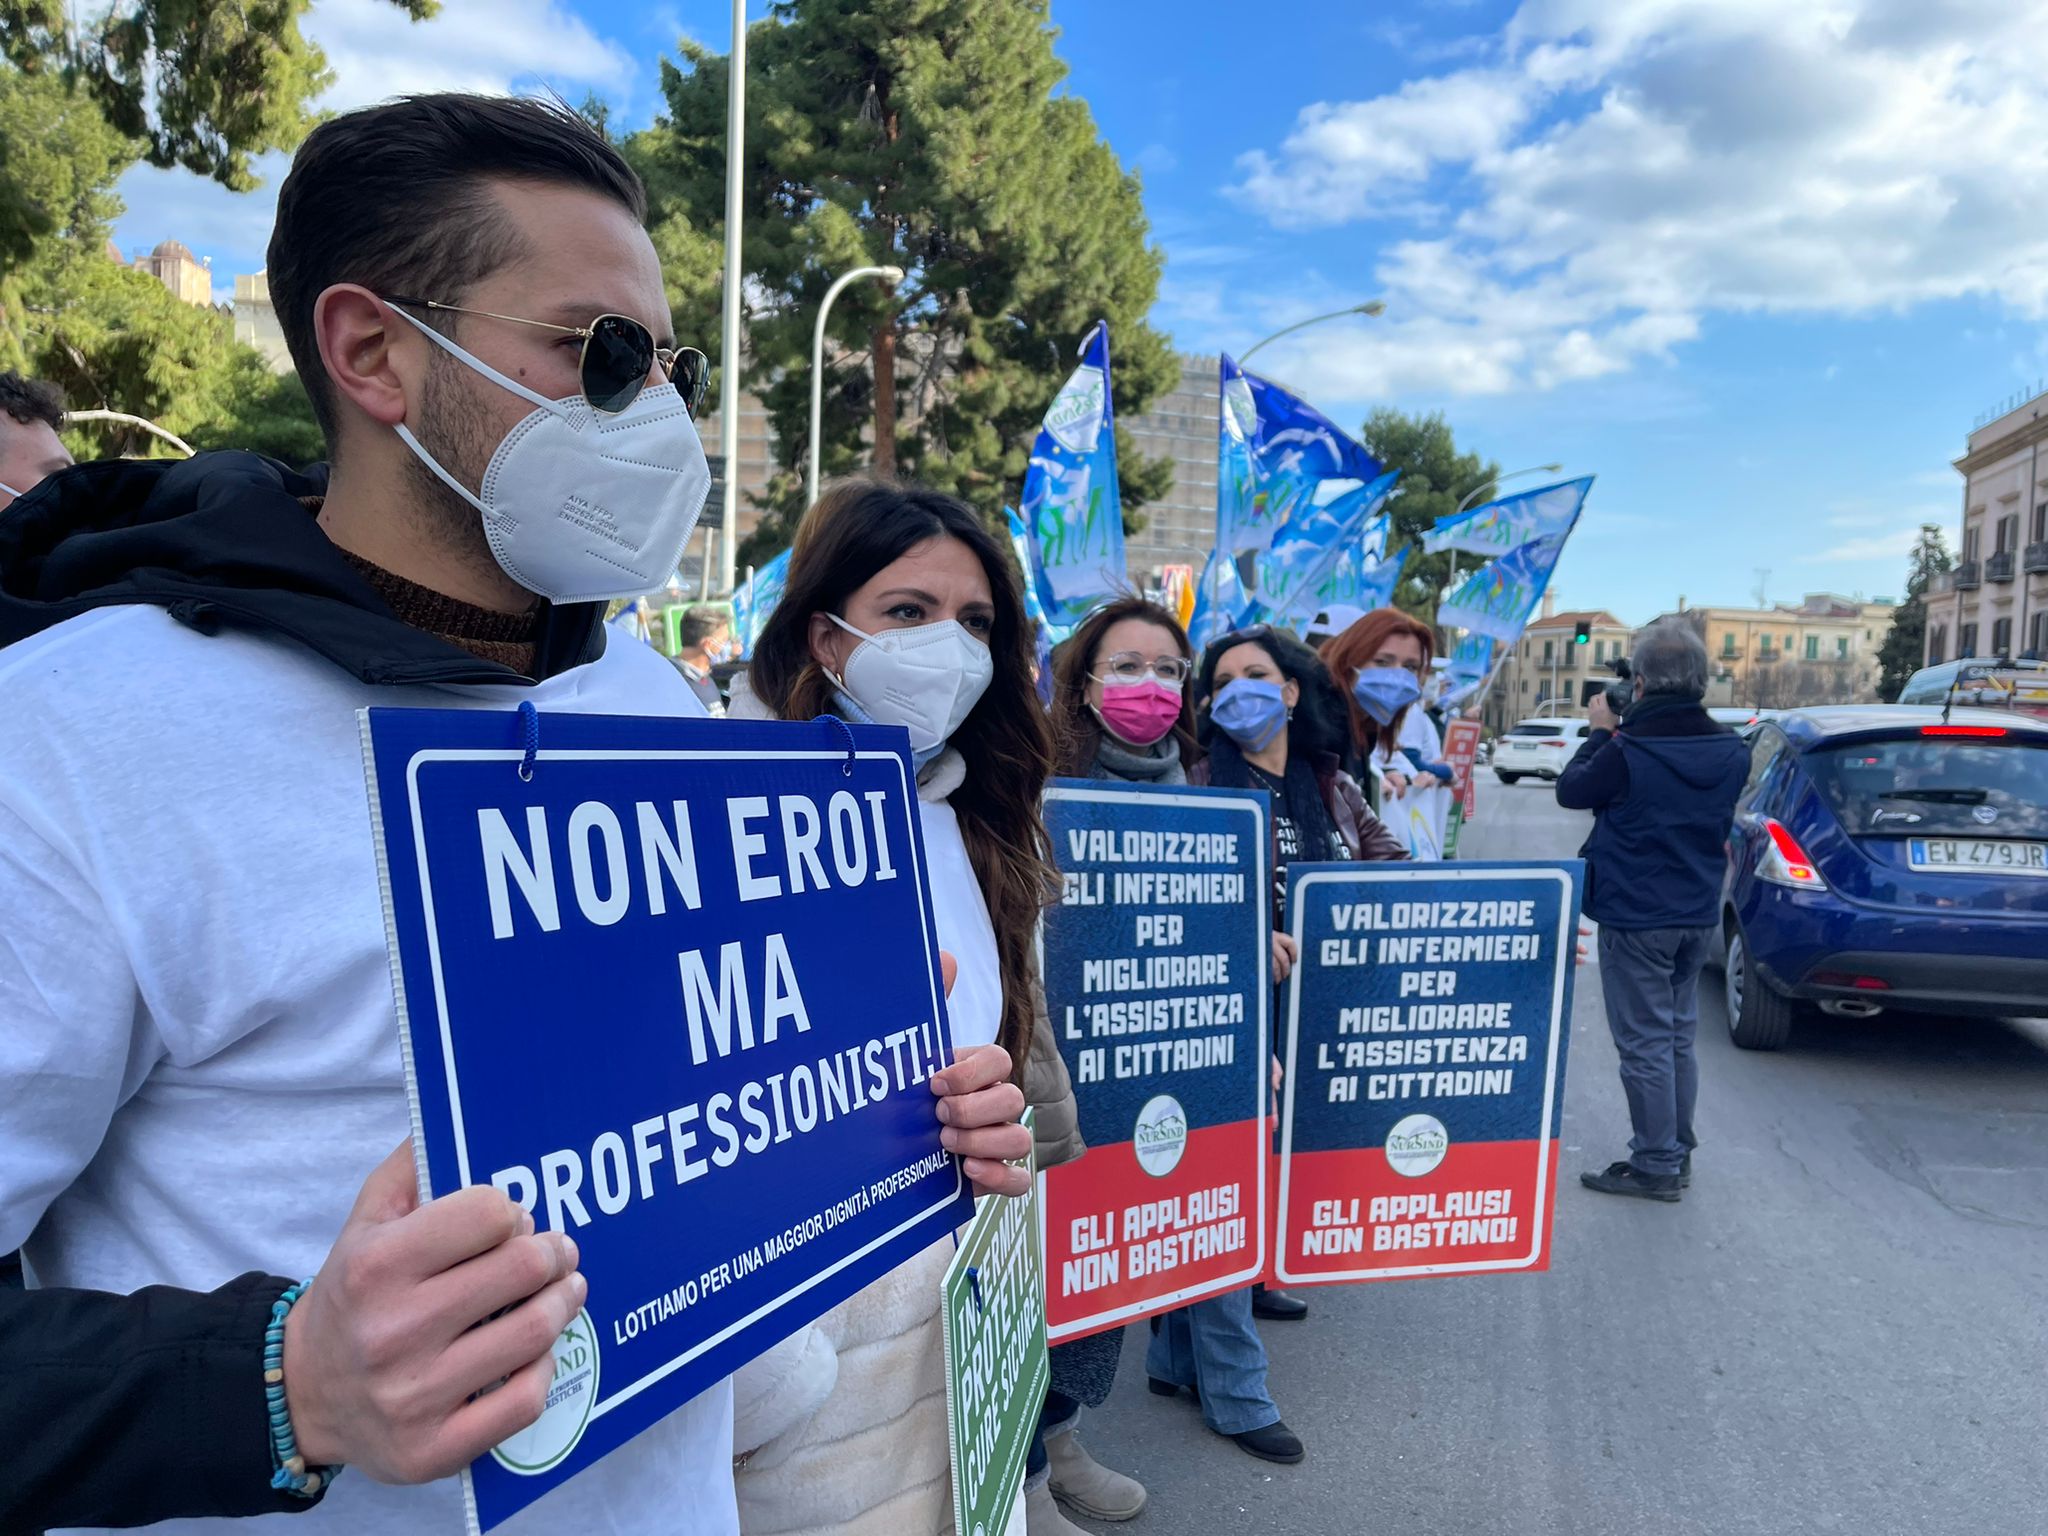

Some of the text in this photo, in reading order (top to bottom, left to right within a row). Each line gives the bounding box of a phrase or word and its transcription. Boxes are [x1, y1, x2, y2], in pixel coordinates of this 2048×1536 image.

[563, 502, 618, 533] GB2626-2006
[593, 505, 614, 520] FFP3
[1069, 830, 1238, 863] VALORIZZARE
[1928, 842, 1957, 862] EW
[478, 791, 896, 939] NON EROI
[1062, 873, 1104, 904] GLI
[1115, 873, 1244, 904] INFERMIERI
[1137, 915, 1183, 946] PER
[1332, 901, 1534, 930] VALORIZZARE
[1322, 935, 1539, 967] GLI INFERMIERI
[1084, 954, 1229, 992] MIGLIORARE
[1401, 971, 1456, 997] PER
[679, 934, 811, 1065] MA
[1067, 994, 1243, 1039] L'ASSISTENZA
[1340, 1003, 1511, 1033] MIGLIORARE
[1079, 1035, 1233, 1083] AI CITTADINI
[1319, 1036, 1527, 1068] L'ASSISTENZA
[1329, 1069, 1512, 1102] AI CITTADINI
[491, 1022, 936, 1232] PROFESSIONISTI!
[1072, 1184, 1240, 1254] GLI APPLAUSI
[1313, 1190, 1511, 1226] GLI APPLAUSI
[615, 1149, 950, 1345] LOTTIAMO PER UNA MAGGIOR DIGNITÀ PROFESSIONALE
[1303, 1217, 1517, 1255] NON BASTANO!
[1063, 1217, 1245, 1296] NON BASTANO!
[962, 1221, 1033, 1446] PROTETTI.
[968, 1380, 1001, 1511] CURE
[1001, 1270, 1040, 1412] SICURE!
